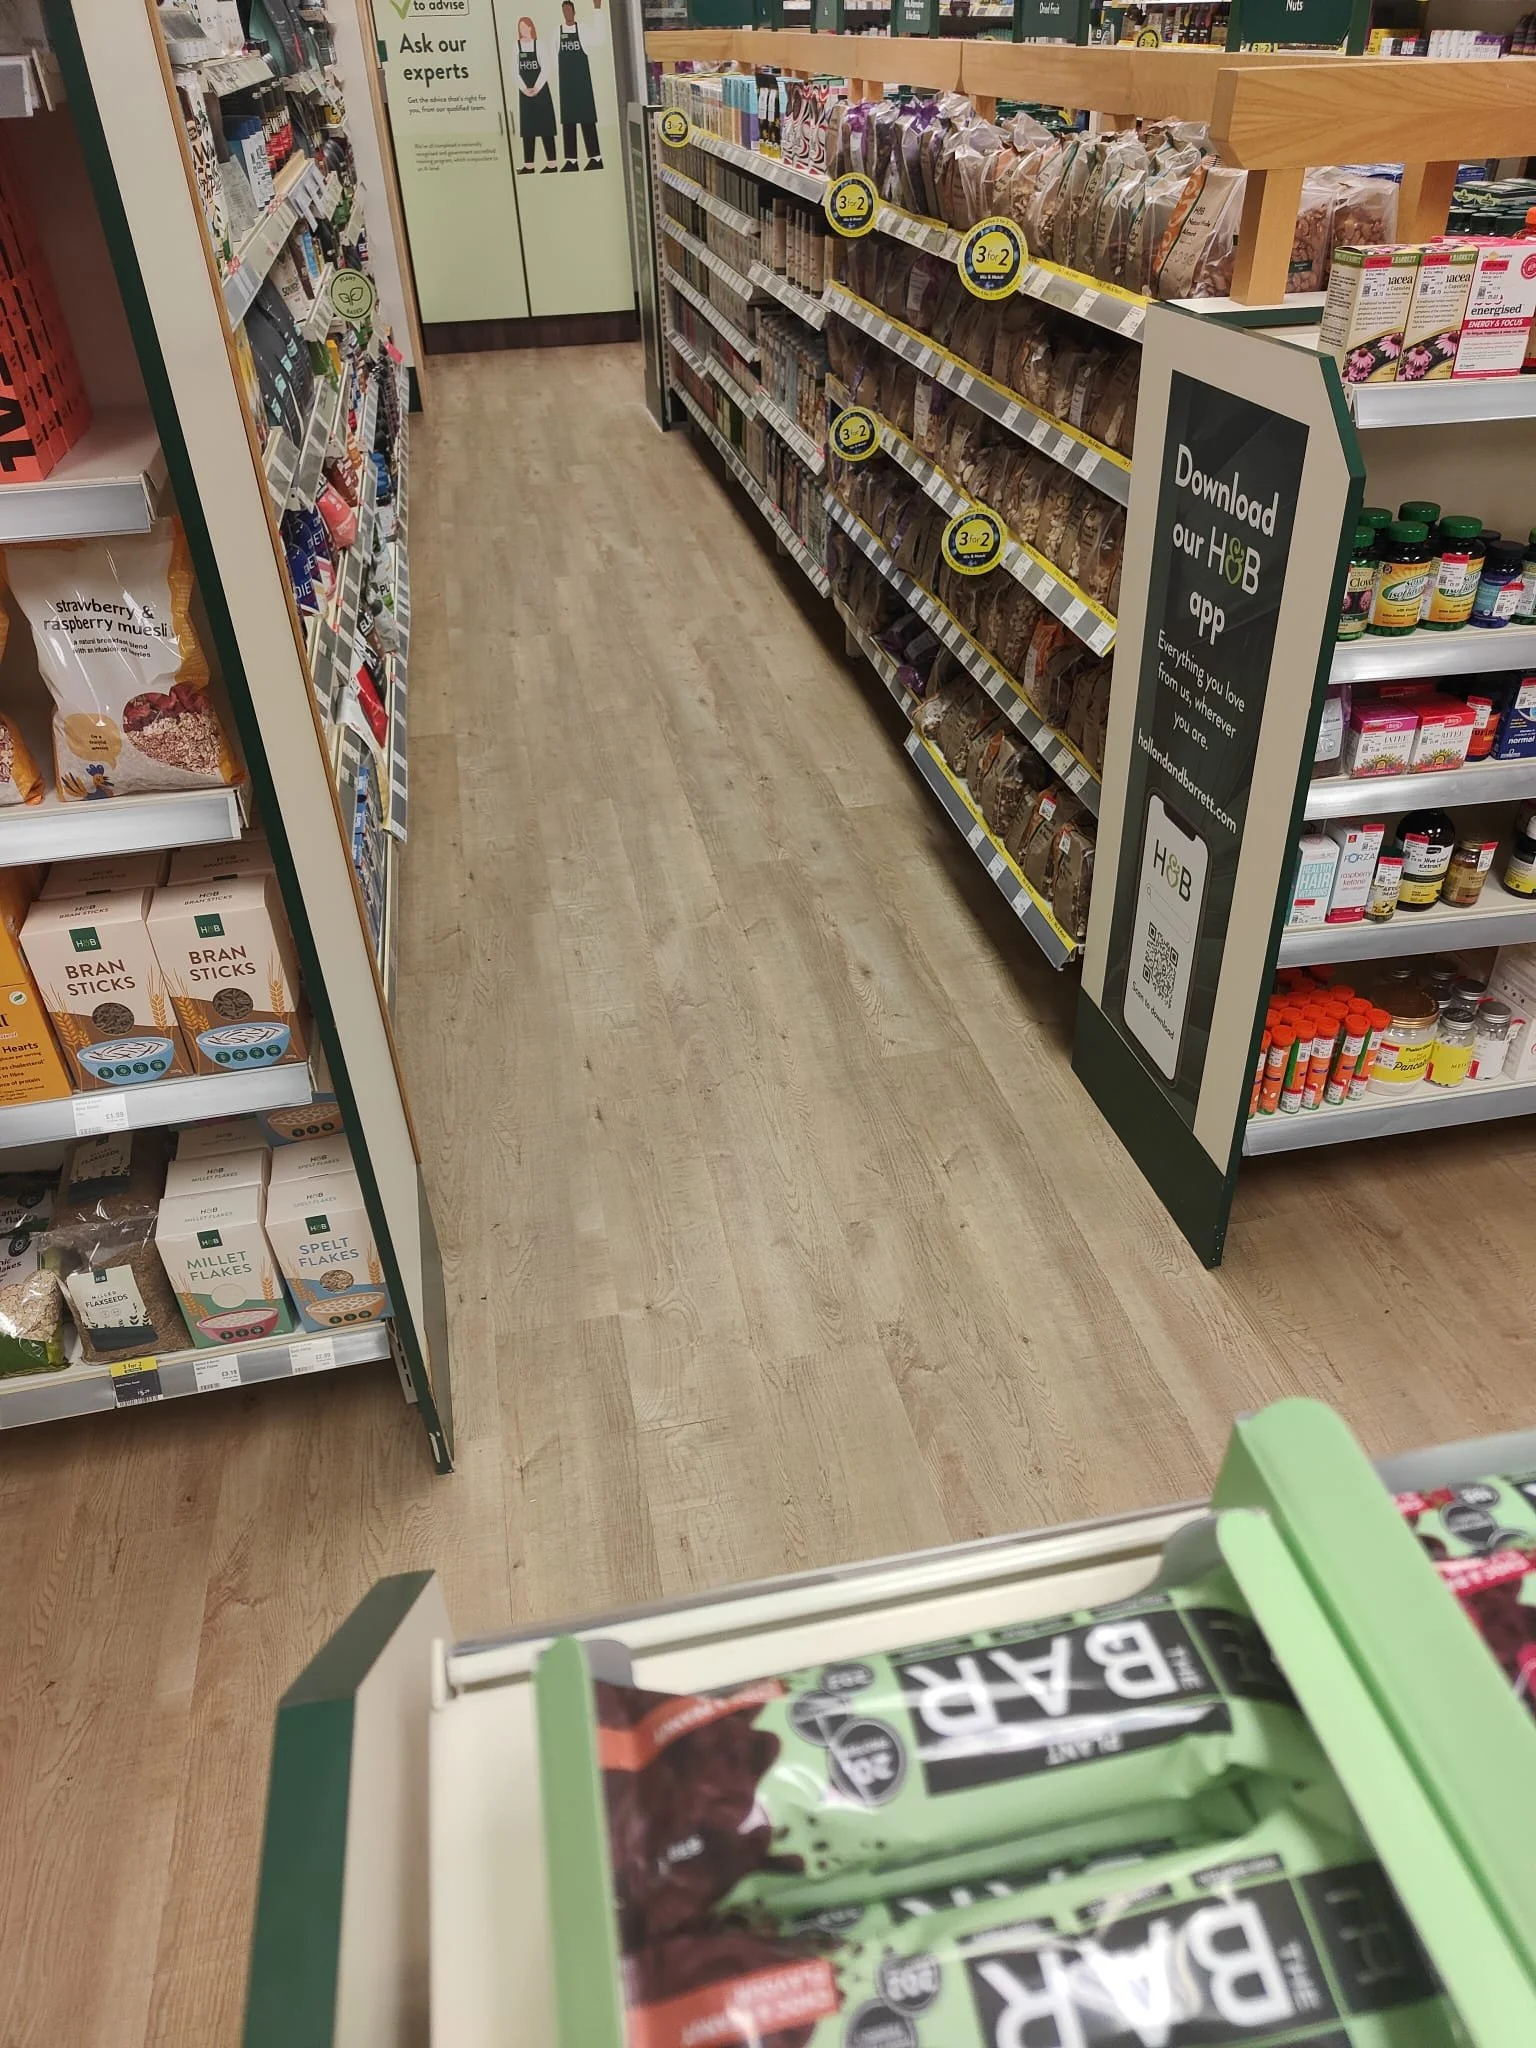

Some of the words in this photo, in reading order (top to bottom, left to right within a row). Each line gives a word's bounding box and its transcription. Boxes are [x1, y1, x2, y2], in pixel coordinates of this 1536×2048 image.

[414, 0, 425, 10] to
[429, 0, 465, 10] advise
[1039, 3, 1050, 15] Dried
[1050, 2, 1060, 14] Fruit
[1286, 0, 1304, 11] Nuts
[400, 32, 434, 53] Ask
[438, 39, 467, 52] our
[403, 64, 469, 88] experts
[666, 120, 673, 130] 3
[678, 121, 683, 131] 2
[839, 196, 847, 210] 3
[847, 200, 857, 208] for
[856, 197, 865, 211] 2
[976, 246, 986, 263] 3
[987, 249, 998, 261] for
[998, 248, 1009, 266] 2
[1471, 304, 1522, 317] energised
[1468, 319, 1495, 328] ENERGY
[1495, 319, 1500, 327] &
[1501, 318, 1523, 327] FOCUS
[843, 428, 850, 440] 3
[859, 425, 867, 437] 2
[1175, 443, 1280, 538] Download
[959, 532, 968, 546] 3
[969, 535, 980, 544] for
[980, 532, 989, 547] 2
[1173, 523, 1204, 559] our
[1207, 526, 1261, 595] H&B
[56, 597, 136, 621] strawberry
[141, 605, 155, 620] &
[1190, 591, 1226, 646] app
[43, 615, 113, 634] raspberry
[117, 621, 168, 638] muesli
[1157, 629, 1205, 688] Everything
[1205, 673, 1223, 696] you
[1225, 681, 1245, 713] love
[1158, 661, 1178, 693] from
[1180, 686, 1192, 708] us,
[1194, 695, 1237, 740] wherever
[1174, 711, 1190, 733] you
[1191, 727, 1208, 751] are.
[1138, 728, 1237, 834] hollandandbarrett.com
[1344, 853, 1375, 863] FORZA
[1153, 839, 1192, 902] H&B
[1303, 863, 1334, 873] HEALTHY
[1341, 871, 1371, 879] raspberry
[1300, 872, 1330, 890] HAIR
[207, 894, 233, 902] STICKS
[1298, 888, 1329, 898] VITAMINS
[59, 911, 81, 919] BRAN
[189, 945, 247, 965] BRAN
[65, 959, 126, 980] BRAN
[190, 962, 257, 982] STICKS
[67, 976, 136, 997] STICKS
[1132, 981, 1145, 999] Scan
[1145, 997, 1151, 1011] to
[1151, 1007, 1175, 1040] download
[2, 1041, 39, 1054] Hearts
[19, 1077, 41, 1085] protein
[0, 1209, 23, 1217] anic
[300, 1237, 349, 1255] SPELT
[186, 1250, 247, 1270] MILLET
[299, 1249, 360, 1268] FLAKES
[189, 1263, 252, 1282] FLAKES
[85, 1293, 129, 1308] FLAXSEEDS
[91, 1291, 117, 1300] MILLED
[1165, 1642, 1203, 1689] THE
[904, 1619, 1180, 1738] BAR
[1047, 1731, 1124, 1768] PLANT
[976, 1902, 1291, 2048] BAR
[1278, 1943, 1318, 2013] THE
